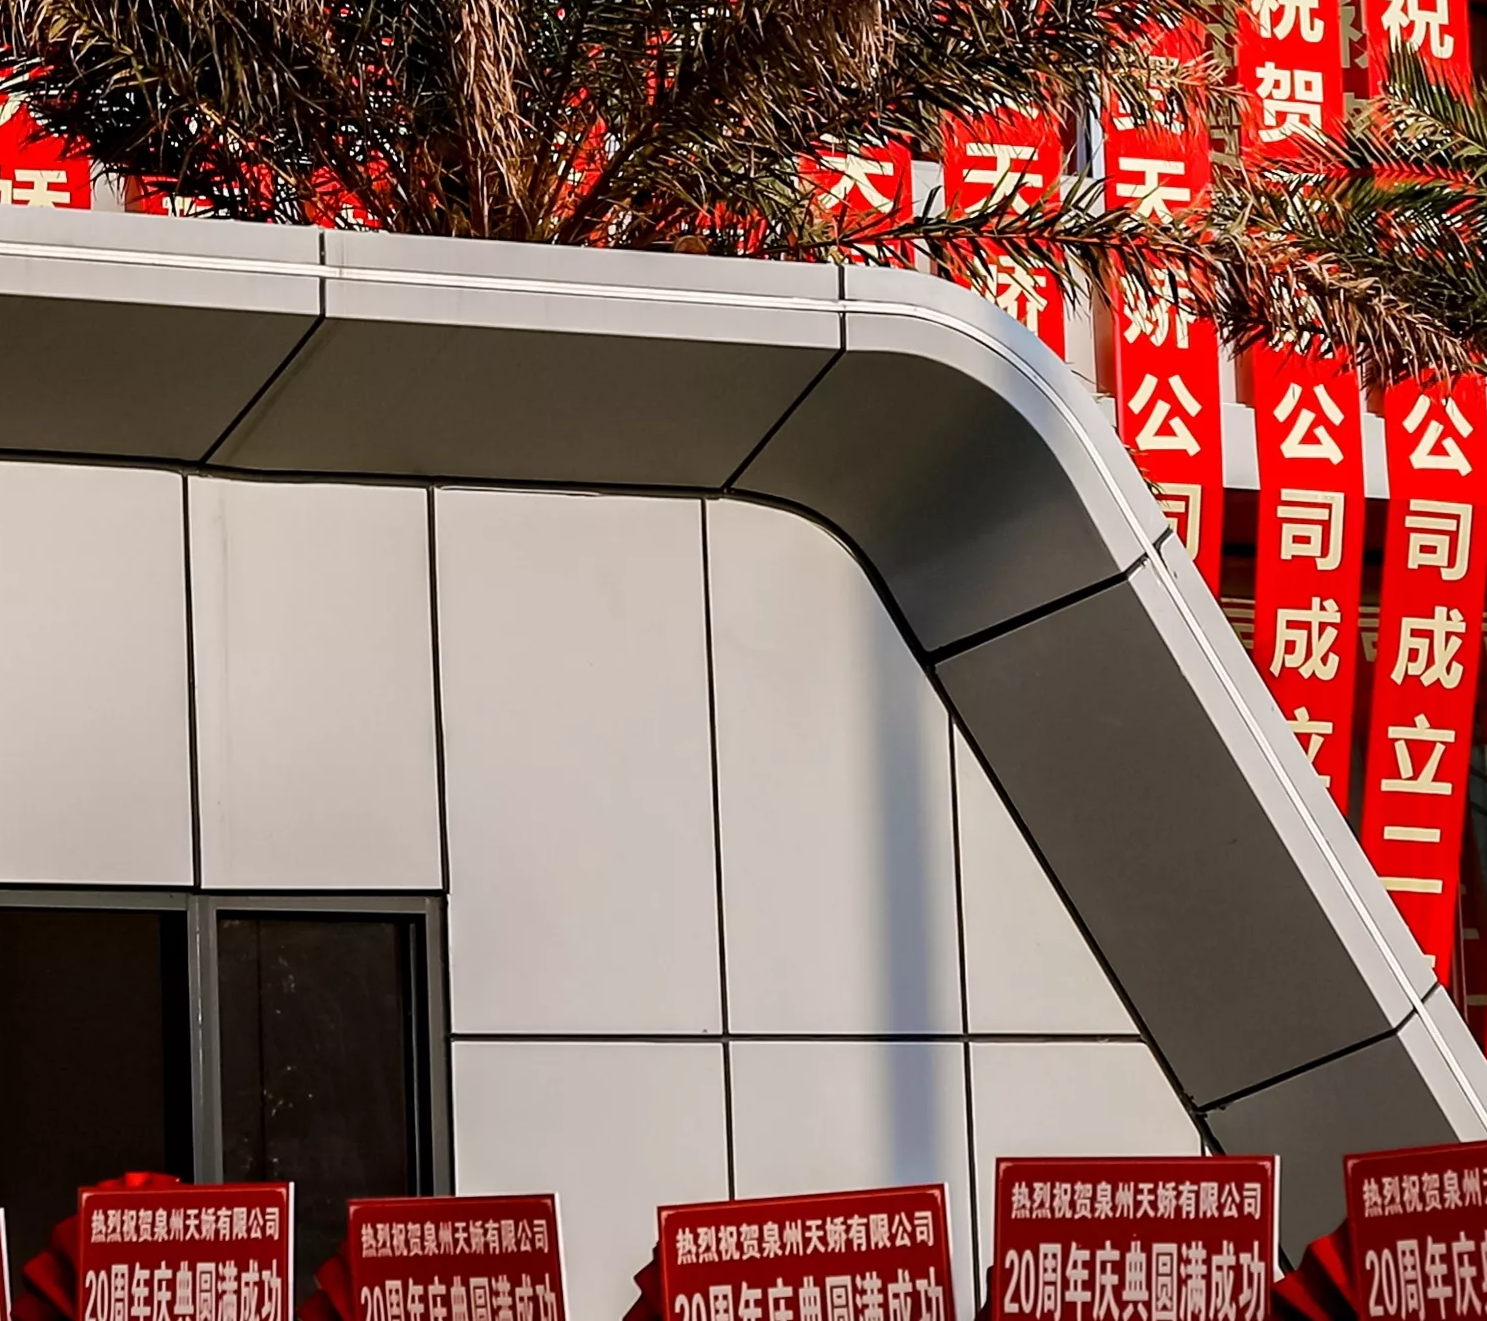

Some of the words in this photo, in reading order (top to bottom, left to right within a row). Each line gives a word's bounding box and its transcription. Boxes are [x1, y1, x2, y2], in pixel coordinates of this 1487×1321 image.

[1010, 1180, 1262, 1221] 热烈祝贺泉州天娇有限公司
[90, 1206, 280, 1242] 热烈祝贺泉州天娇有限公司
[360, 1218, 549, 1258] 热烈祝贺泉州天娇有限公司
[675, 1210, 935, 1266] 热烈祝贺泉州天娇有限公司
[1002, 1240, 1267, 1321] 20周年庆典圆满成功
